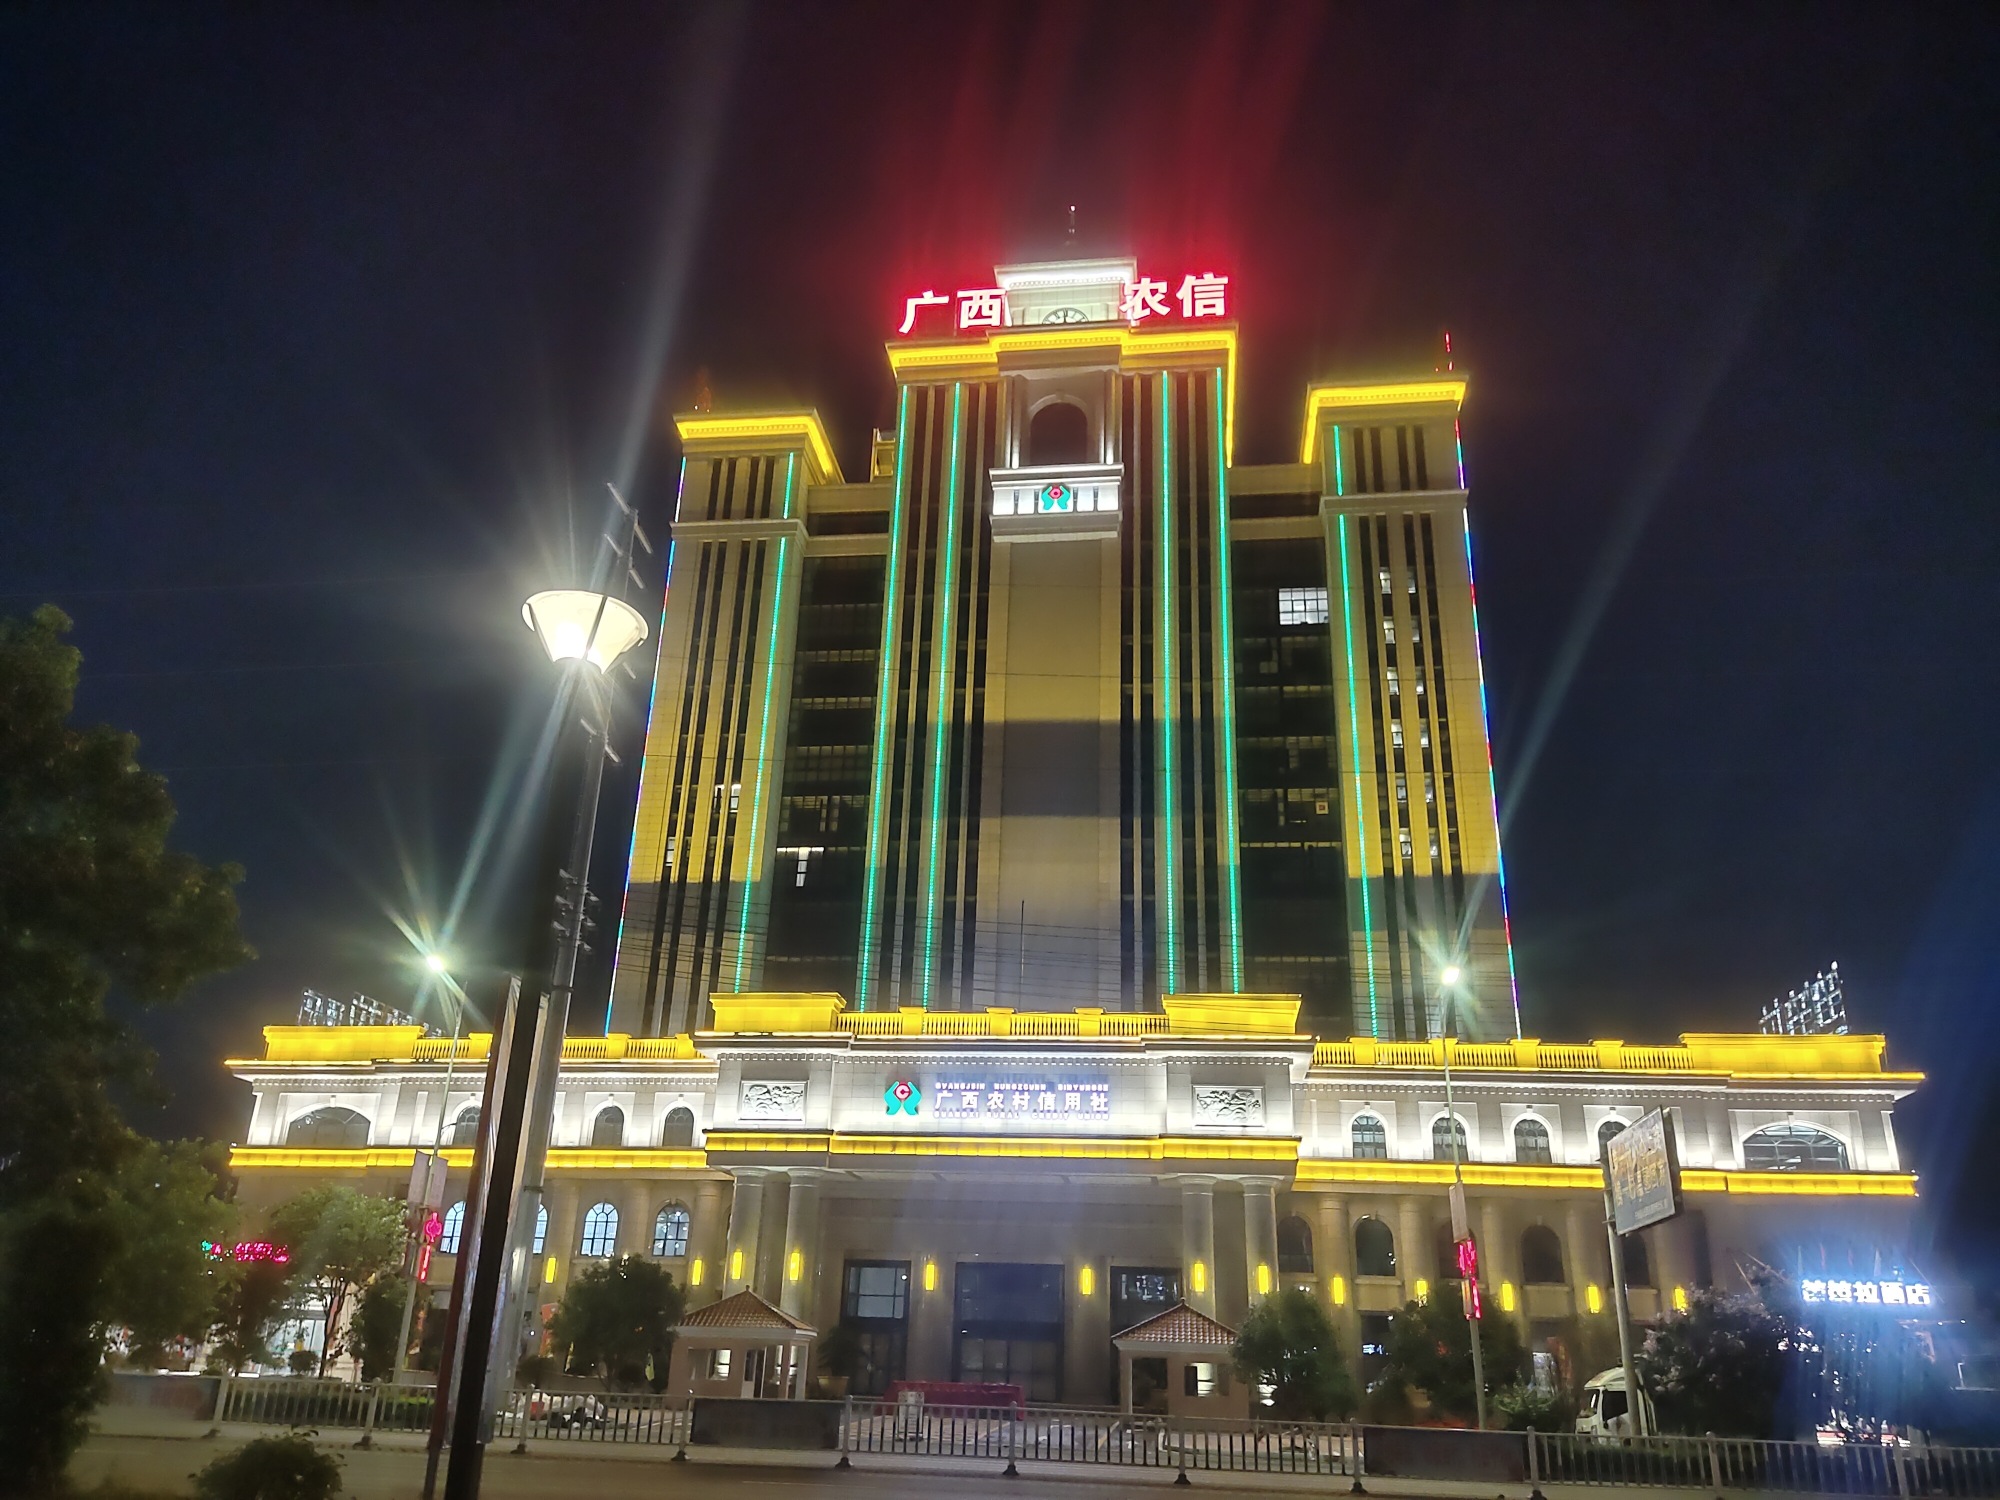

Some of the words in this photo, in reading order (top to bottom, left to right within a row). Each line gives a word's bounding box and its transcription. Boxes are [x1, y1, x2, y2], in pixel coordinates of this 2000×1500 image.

[899, 289, 1007, 334] 广西
[1120, 272, 1229, 320] 农信
[934, 1090, 1109, 1111] 广西农村信用社
